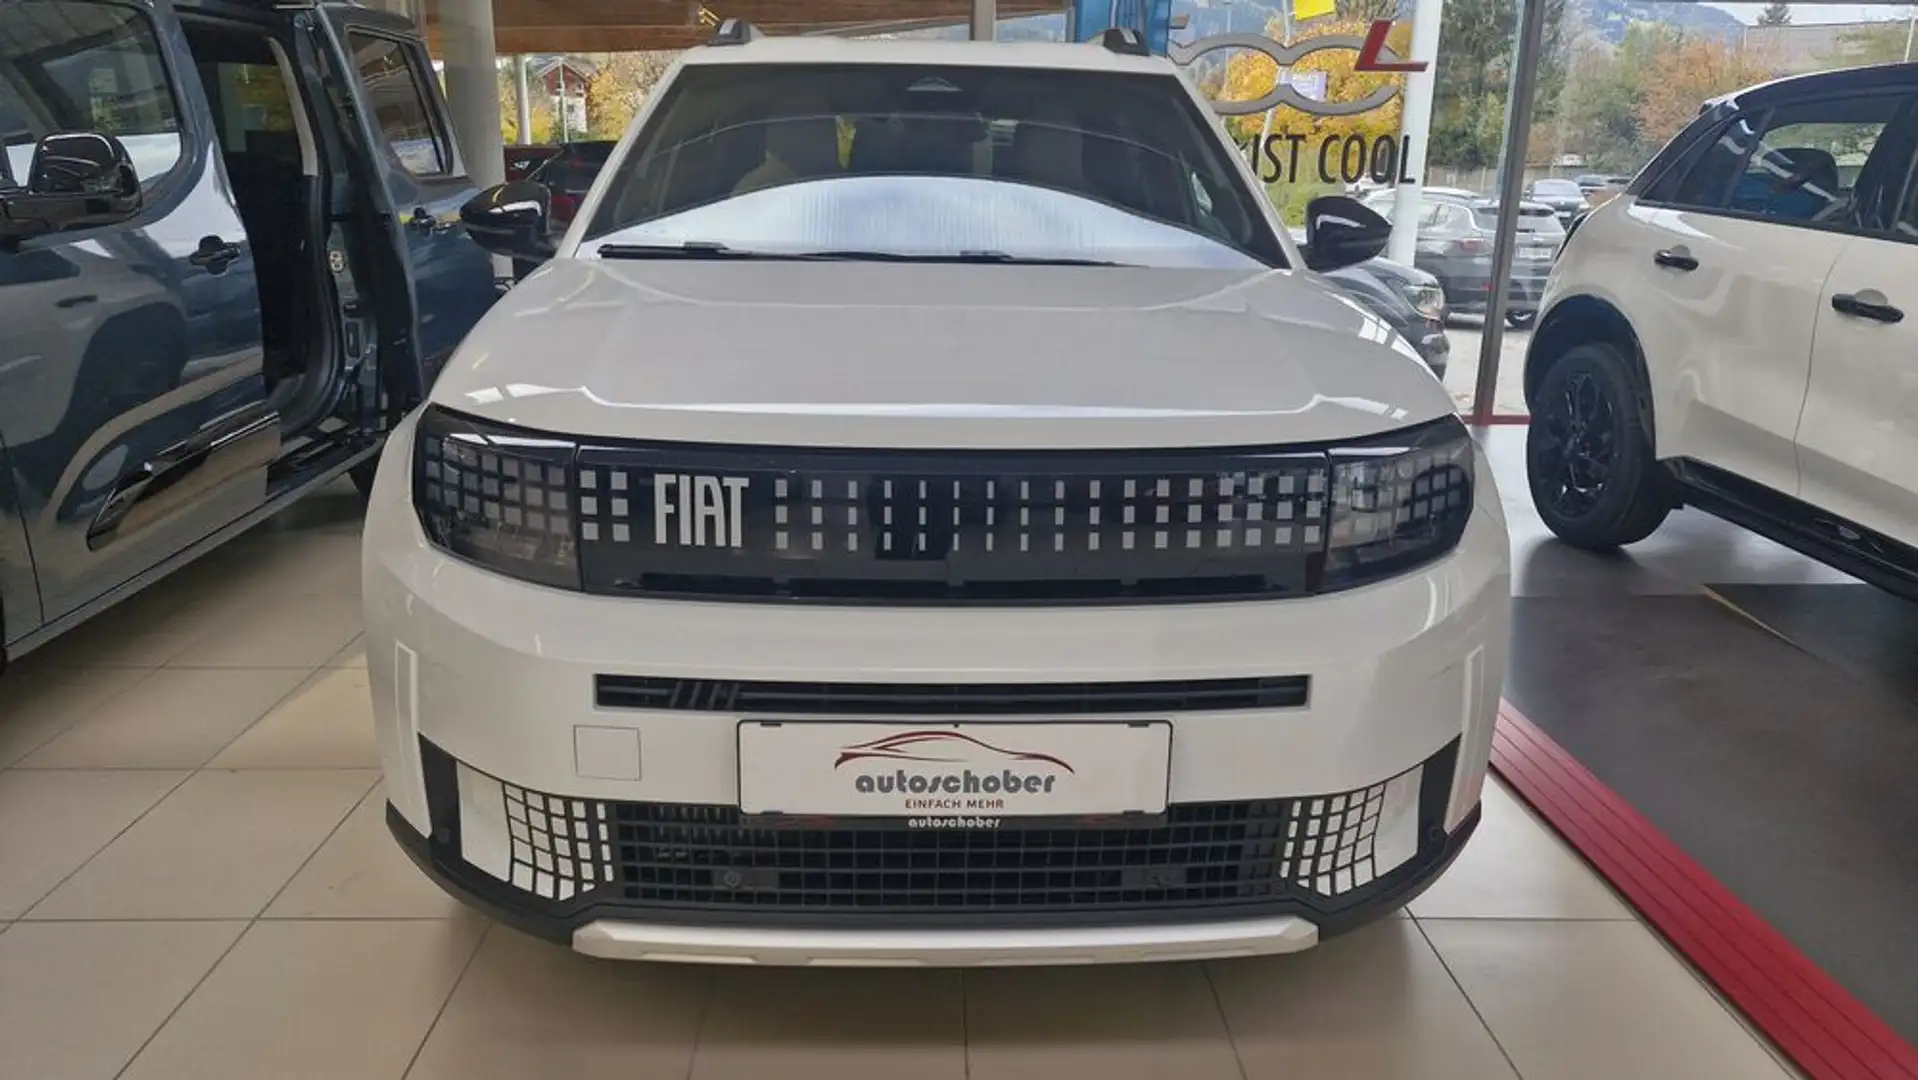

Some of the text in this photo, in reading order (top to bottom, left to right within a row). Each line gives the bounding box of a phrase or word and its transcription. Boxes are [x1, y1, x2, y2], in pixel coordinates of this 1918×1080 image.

[1318, 133, 1416, 185] COOL
[653, 473, 750, 549] FIAT
[855, 769, 1056, 794] autoschober
[904, 798, 1005, 810] EINFACH MEHR
[908, 815, 1001, 829] autoschober
